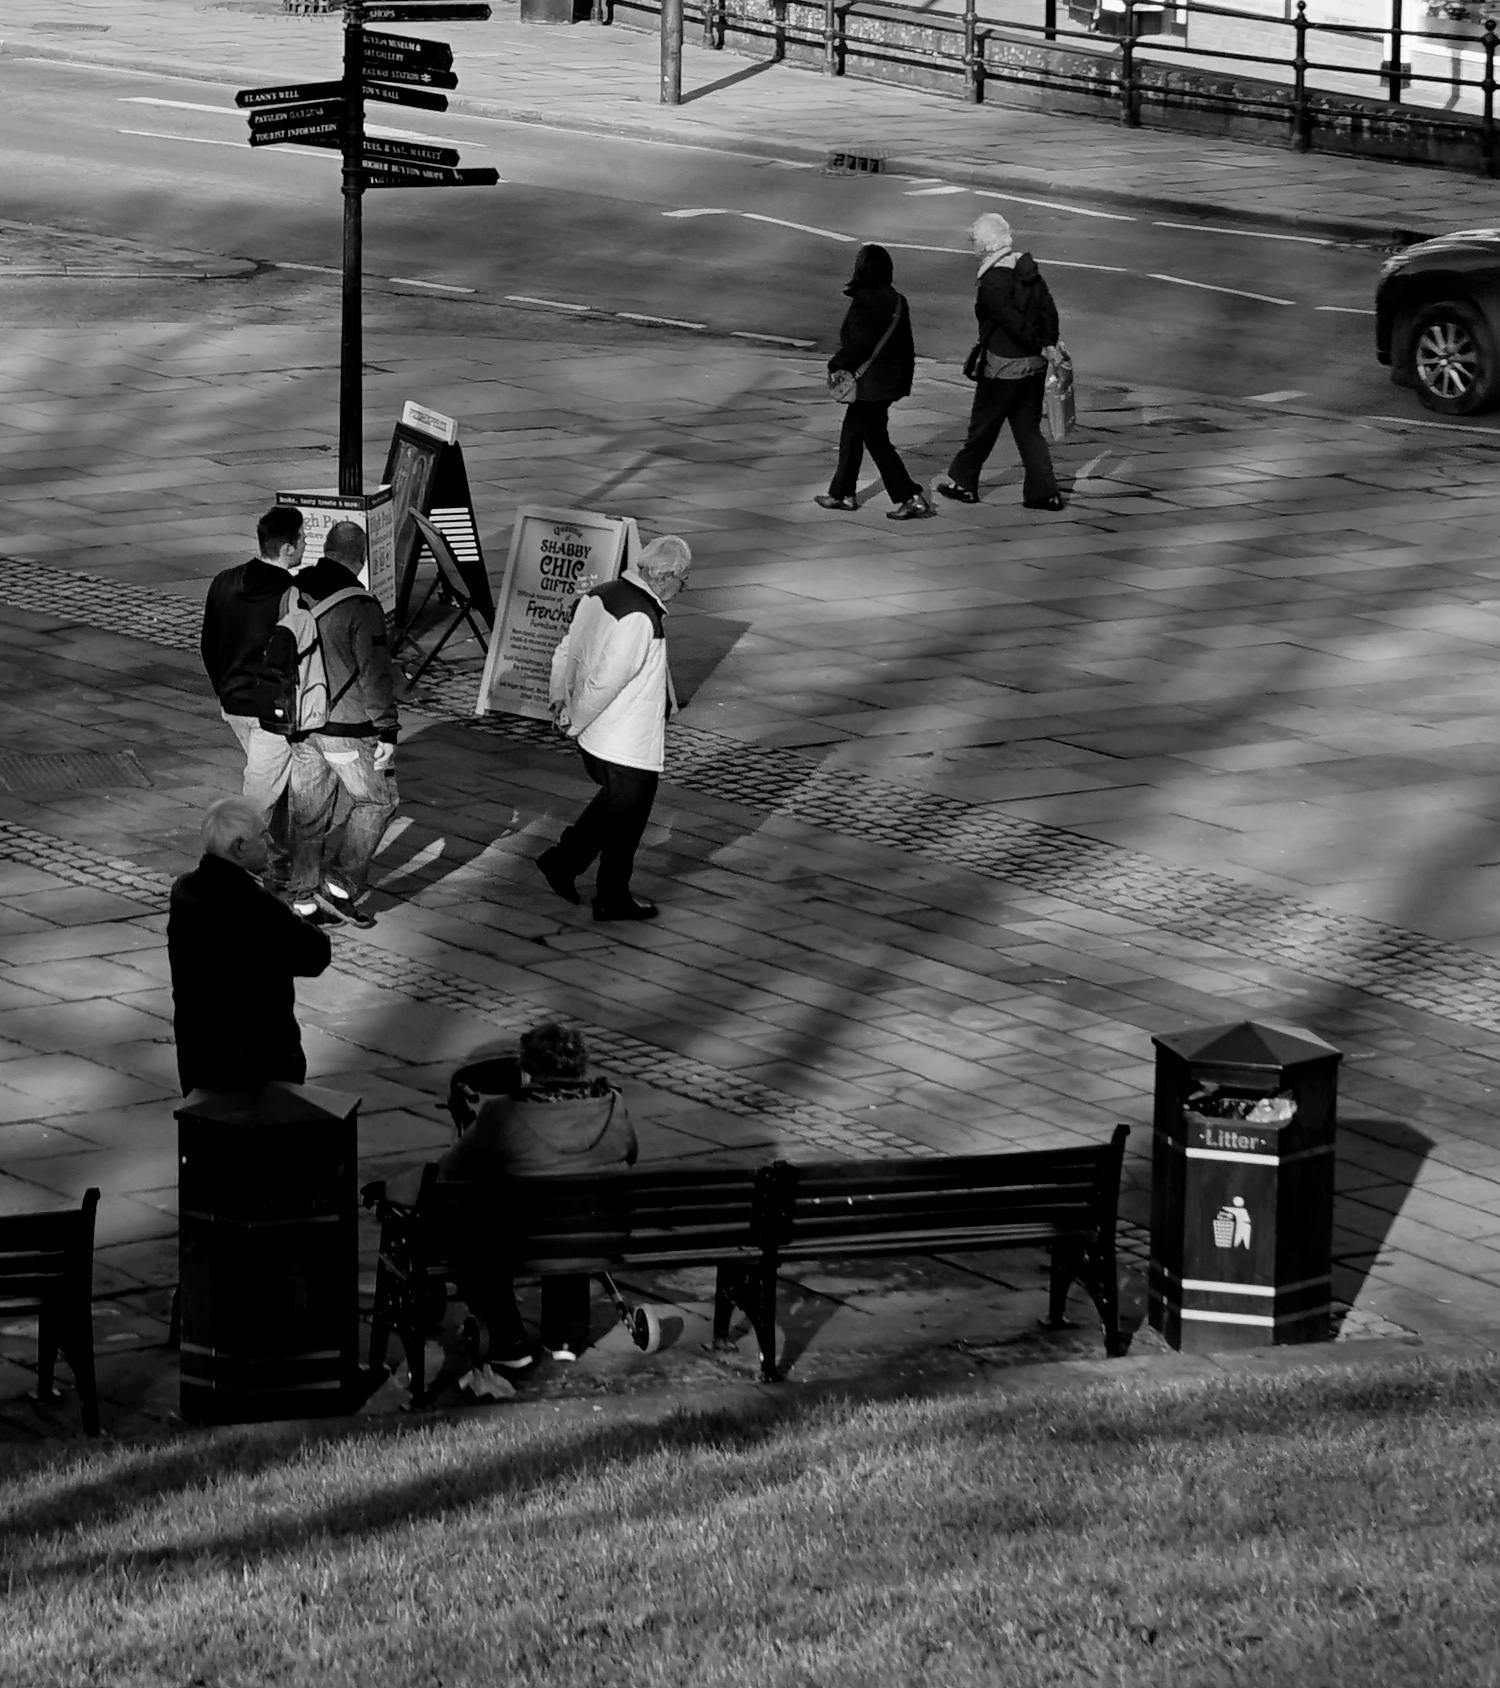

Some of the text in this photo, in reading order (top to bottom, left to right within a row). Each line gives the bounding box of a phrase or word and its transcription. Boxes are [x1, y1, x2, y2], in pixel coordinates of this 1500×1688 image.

[255, 123, 337, 142] TOURIST INFORMATION
[540, 539, 593, 559] SHABBY
[539, 555, 586, 581] CHIC
[540, 577, 576, 595] GIFTS
[1206, 1128, 1259, 1150] Litter
